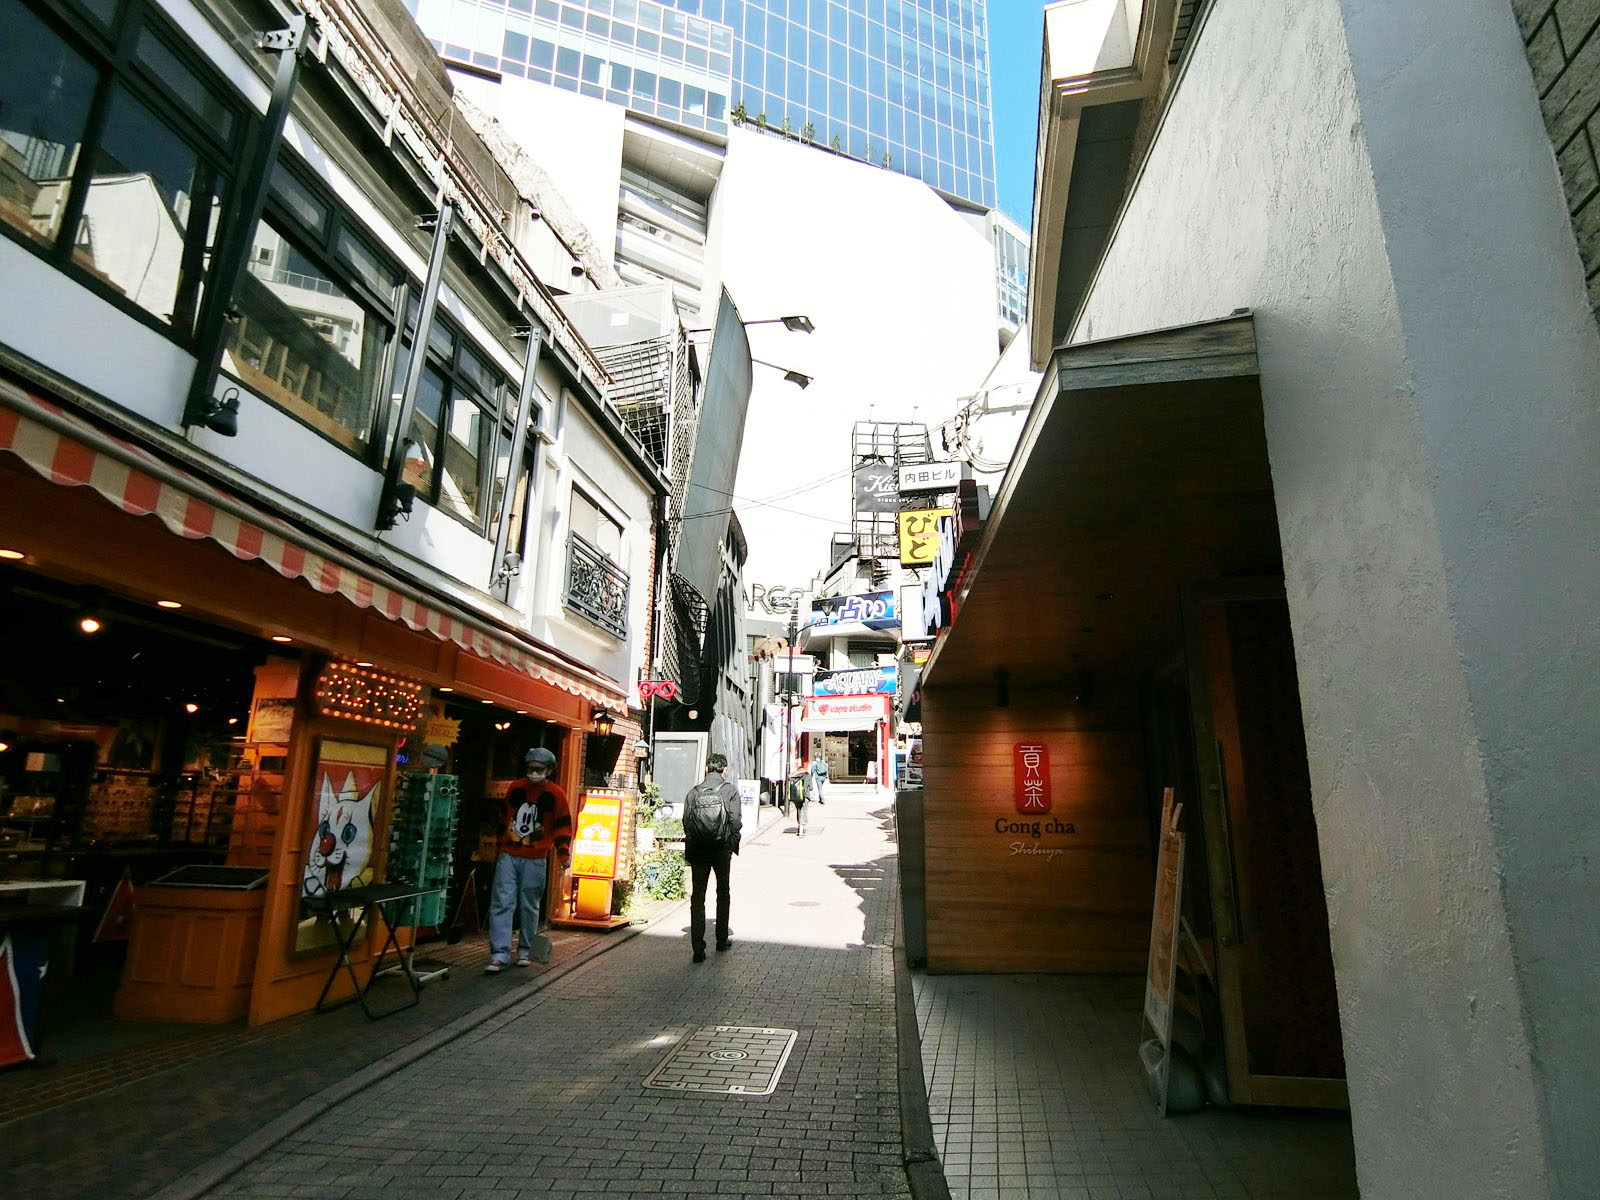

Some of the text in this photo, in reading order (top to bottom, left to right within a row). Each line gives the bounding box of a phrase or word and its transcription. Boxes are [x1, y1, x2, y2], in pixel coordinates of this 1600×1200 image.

[904, 469, 955, 484] 内田ビル
[829, 670, 881, 690] AQUARY
[1018, 744, 1045, 808] 貢茶
[994, 818, 1076, 839] Gong cha
[1009, 841, 1064, 862] Shibuya
